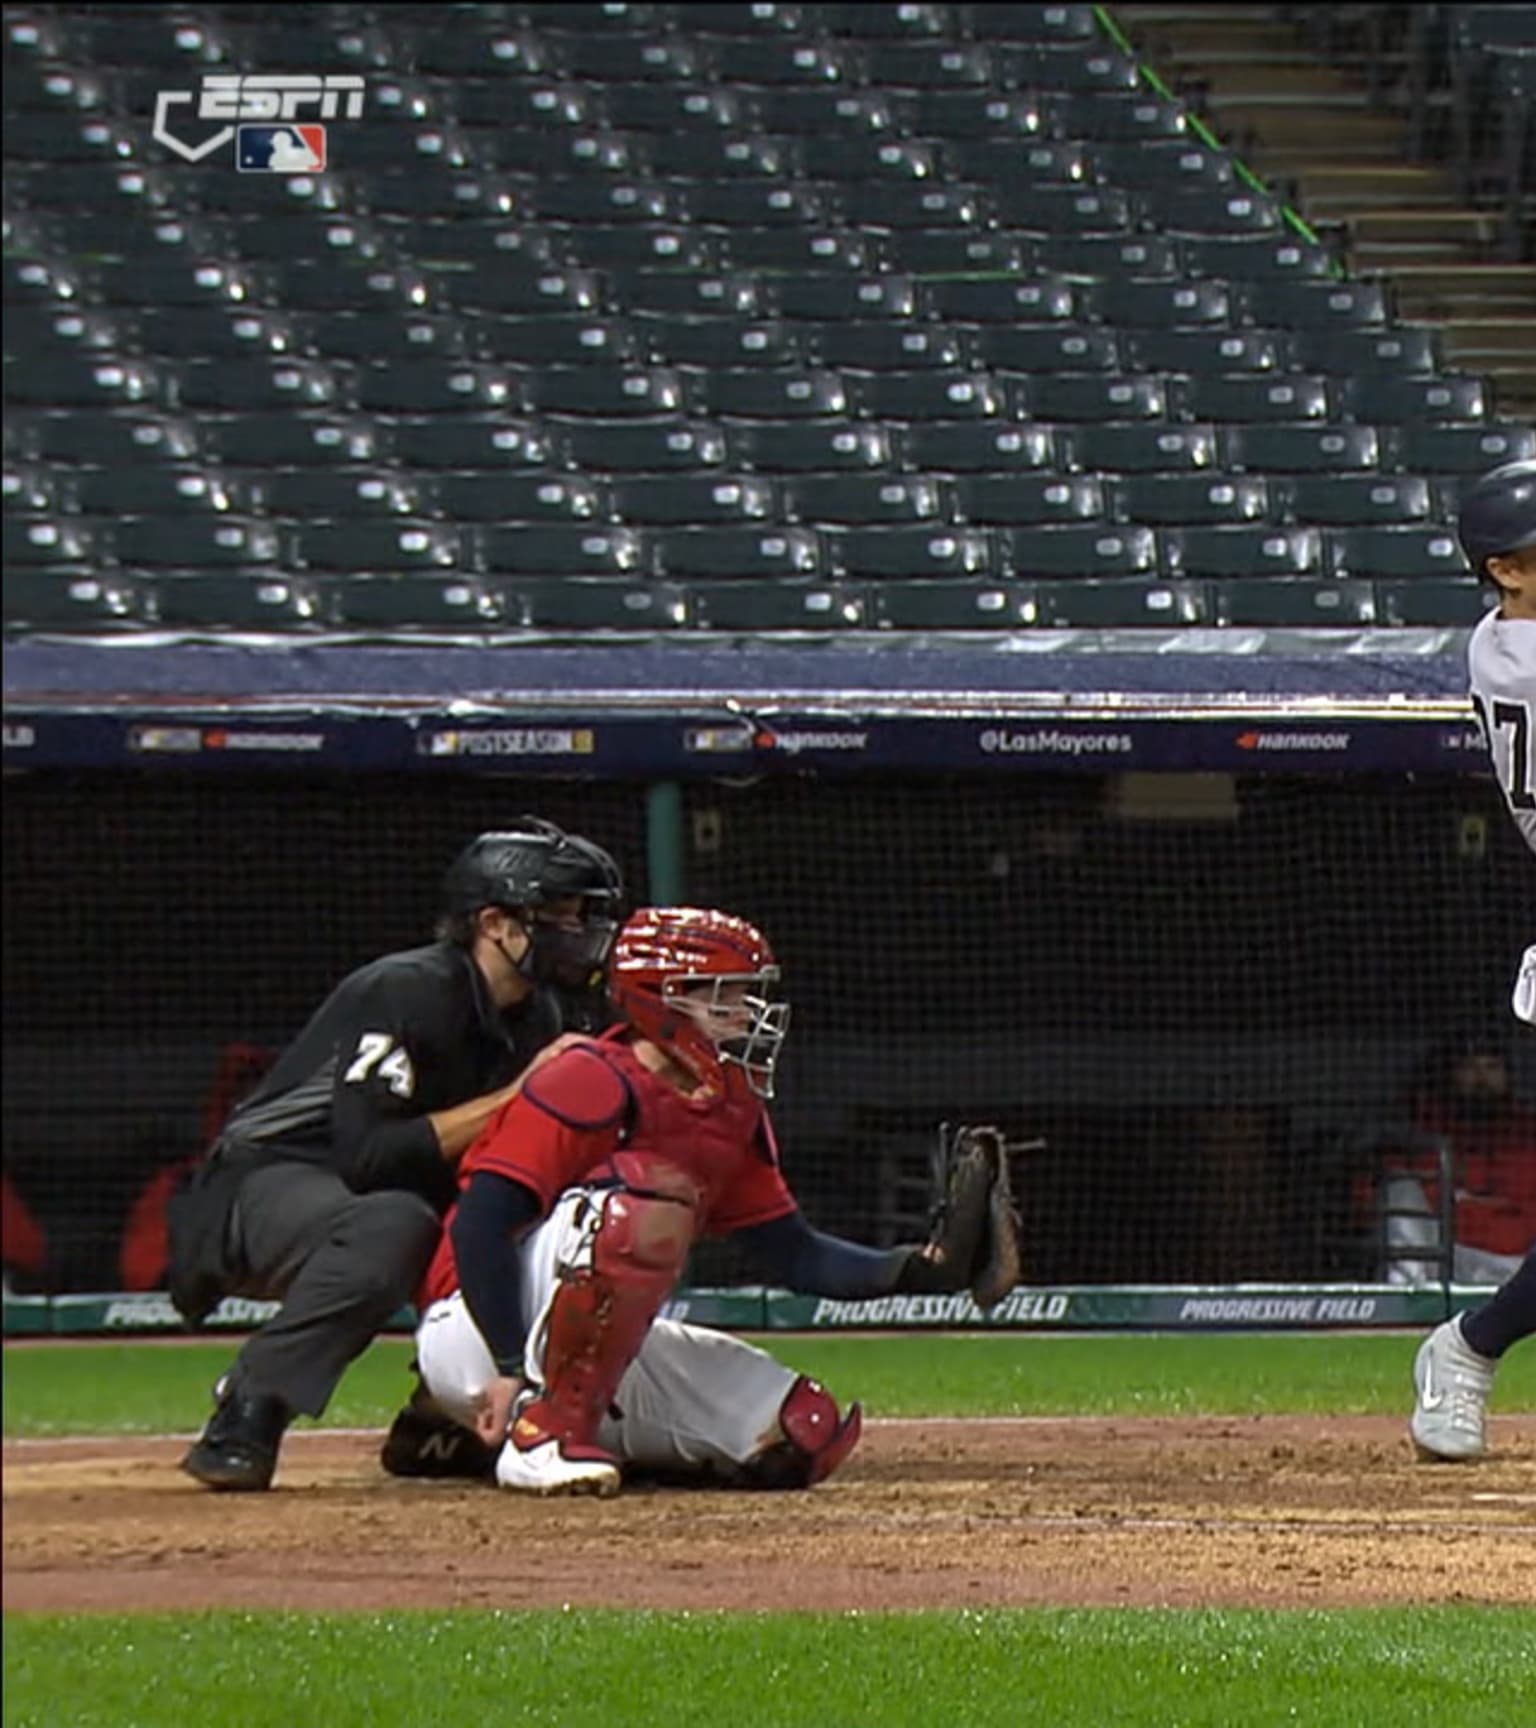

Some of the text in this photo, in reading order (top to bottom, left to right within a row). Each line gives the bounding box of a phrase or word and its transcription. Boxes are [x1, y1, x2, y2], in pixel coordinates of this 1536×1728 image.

[980, 730, 1132, 756] @LasMayores
[344, 1033, 415, 1099] 74
[991, 1294, 1068, 1321] FIELD
[1179, 1299, 1377, 1321] PROGRESSIVE FIELD
